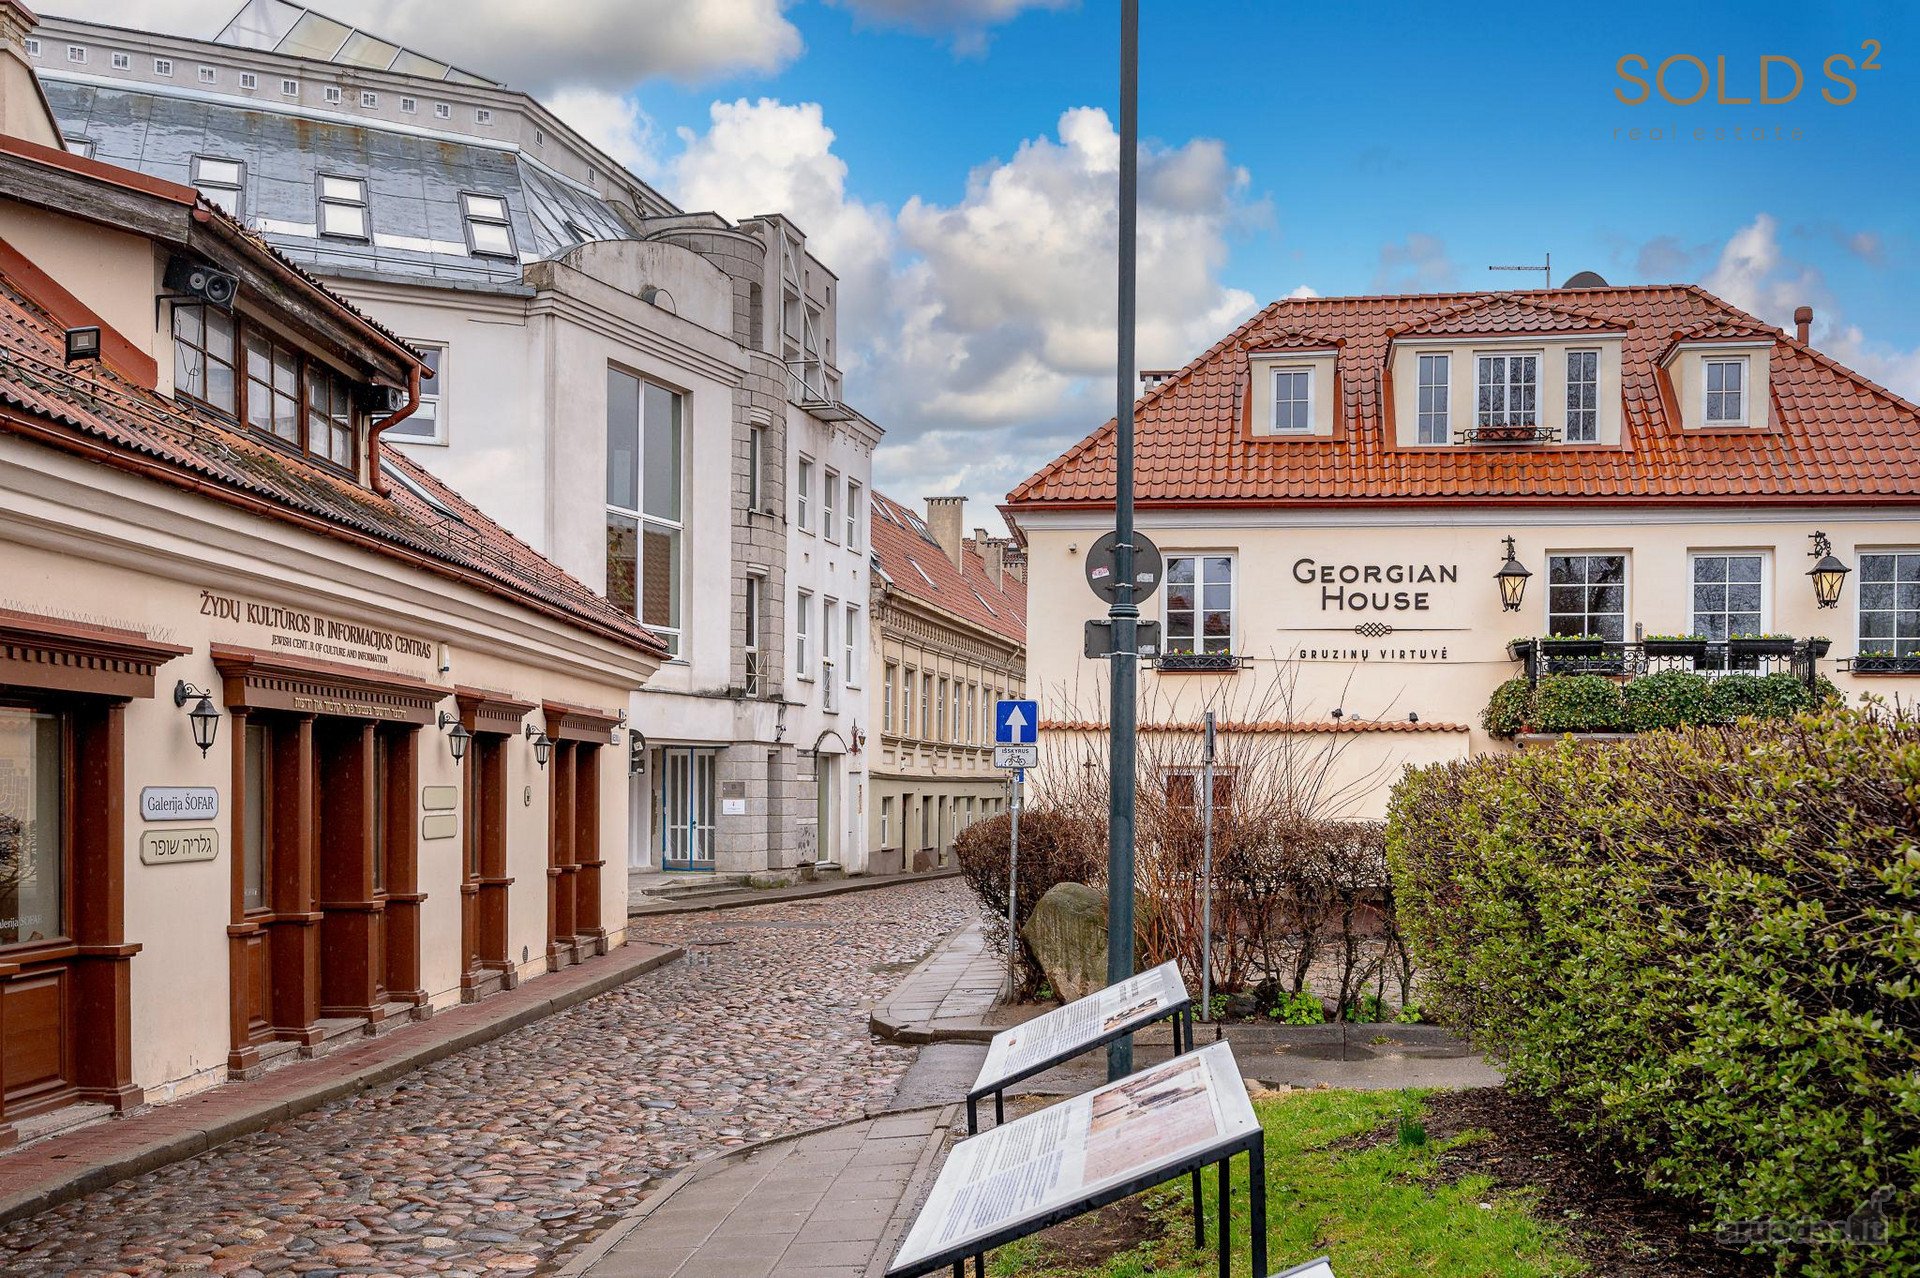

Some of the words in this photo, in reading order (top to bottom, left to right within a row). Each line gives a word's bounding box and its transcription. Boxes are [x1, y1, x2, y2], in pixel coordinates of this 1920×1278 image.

[200, 590, 241, 623] ŽYDŲ
[247, 602, 310, 633] KULTŪROS
[314, 617, 325, 636] IR
[327, 620, 393, 651] INFORMACIJOS
[395, 635, 432, 659] CENTRAS
[271, 634, 292, 646] JEWISH
[292, 638, 315, 652] CENTR
[315, 642, 323, 653] OF
[322, 644, 346, 657] CULTURE
[346, 649, 358, 660] AND
[1300, 648, 1369, 662] GRUZINŲ
[1380, 646, 1448, 660] VIRTUVĖ
[147, 796, 184, 815] Galerija
[184, 791, 215, 811] ŠOFAR
[150, 839, 181, 857] שופר
[181, 833, 212, 855] גלריה
